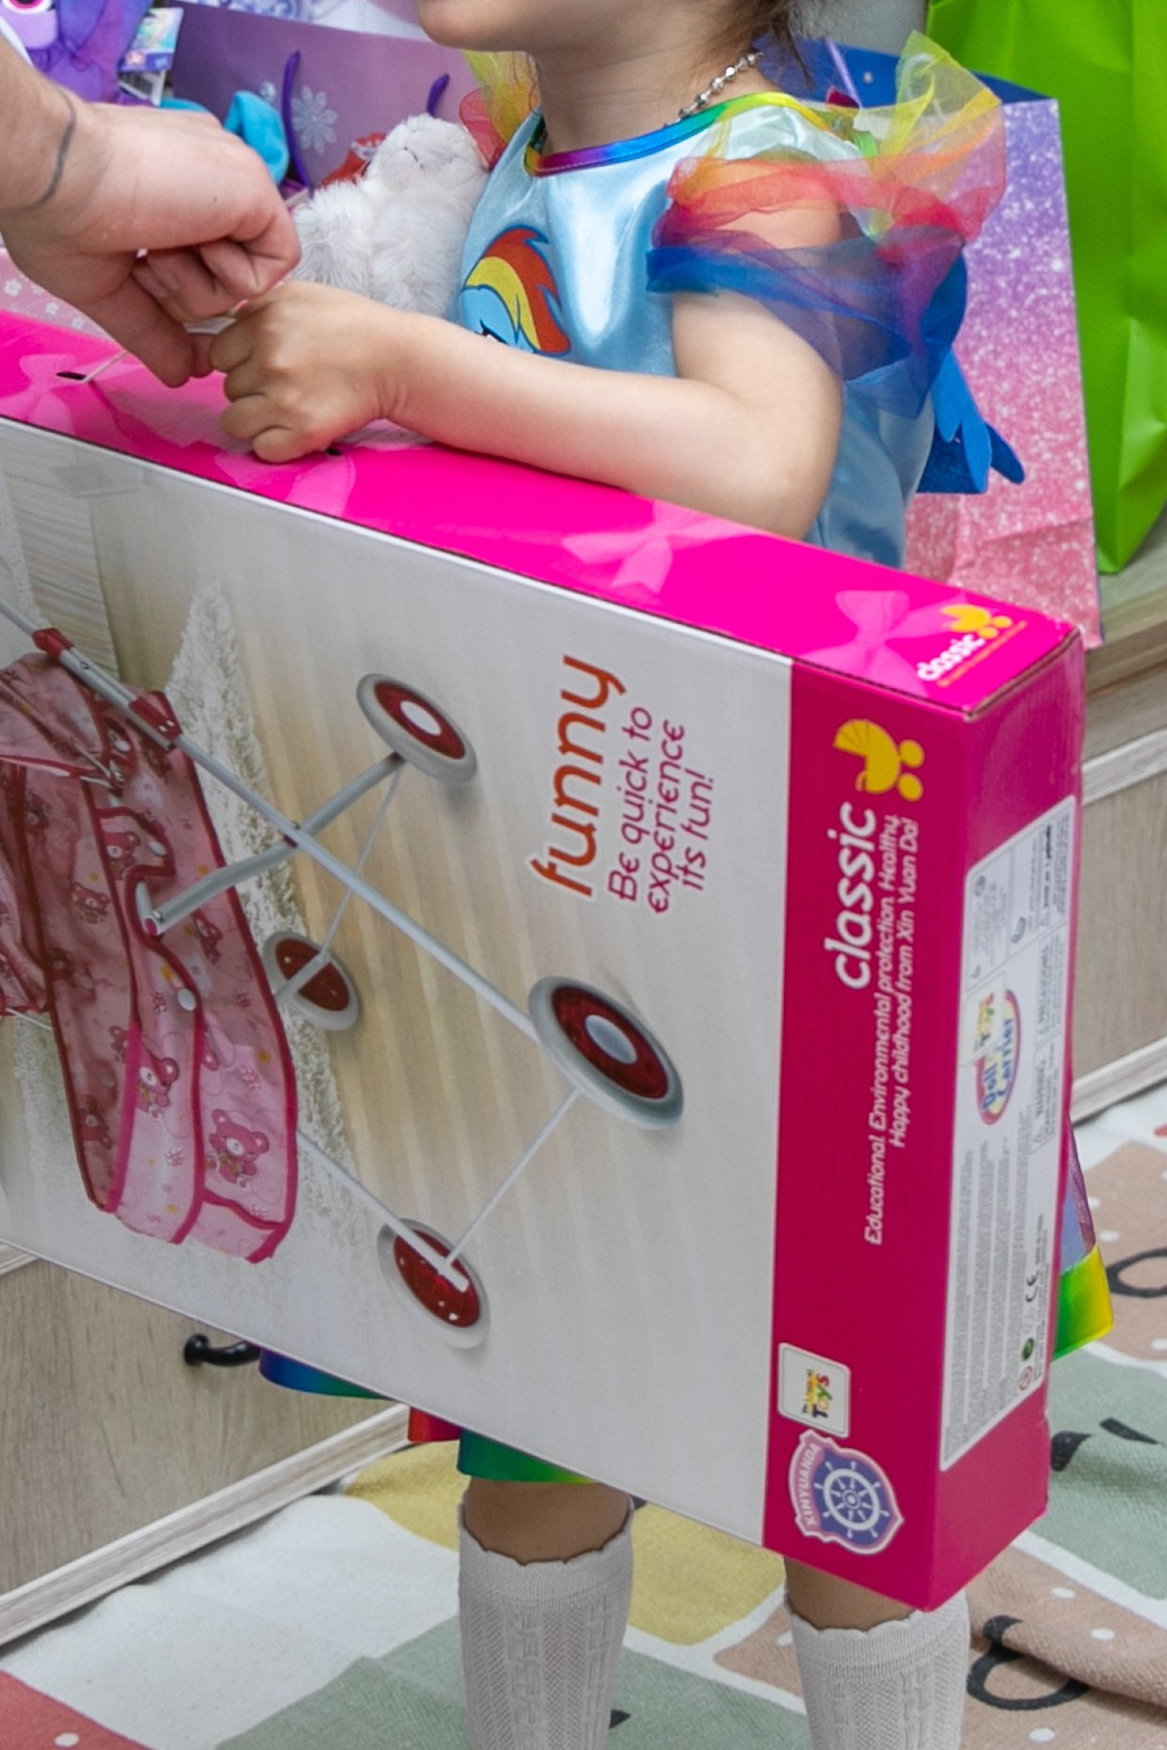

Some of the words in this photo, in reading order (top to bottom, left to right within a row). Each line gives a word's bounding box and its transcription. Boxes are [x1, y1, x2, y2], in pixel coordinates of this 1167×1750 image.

[917, 633, 986, 681] classic
[621, 707, 653, 742] to
[530, 653, 627, 897] funny
[616, 750, 651, 845] quick
[680, 768, 715, 840] fun!
[647, 718, 686, 914] experience
[898, 817, 920, 854] Da!
[607, 852, 641, 902] Be
[675, 847, 708, 891] its
[823, 801, 877, 990] classic
[898, 854, 918, 906] Yuan
[896, 909, 915, 942] Xin
[895, 943, 914, 993] from
[868, 992, 892, 1133] Environmental
[891, 989, 914, 1084] childhood
[994, 1018, 1013, 1098] Carrier
[889, 1085, 911, 1149] Happy
[811, 1373, 833, 1419] Toys
[798, 1442, 822, 1527] XINYUANDA
